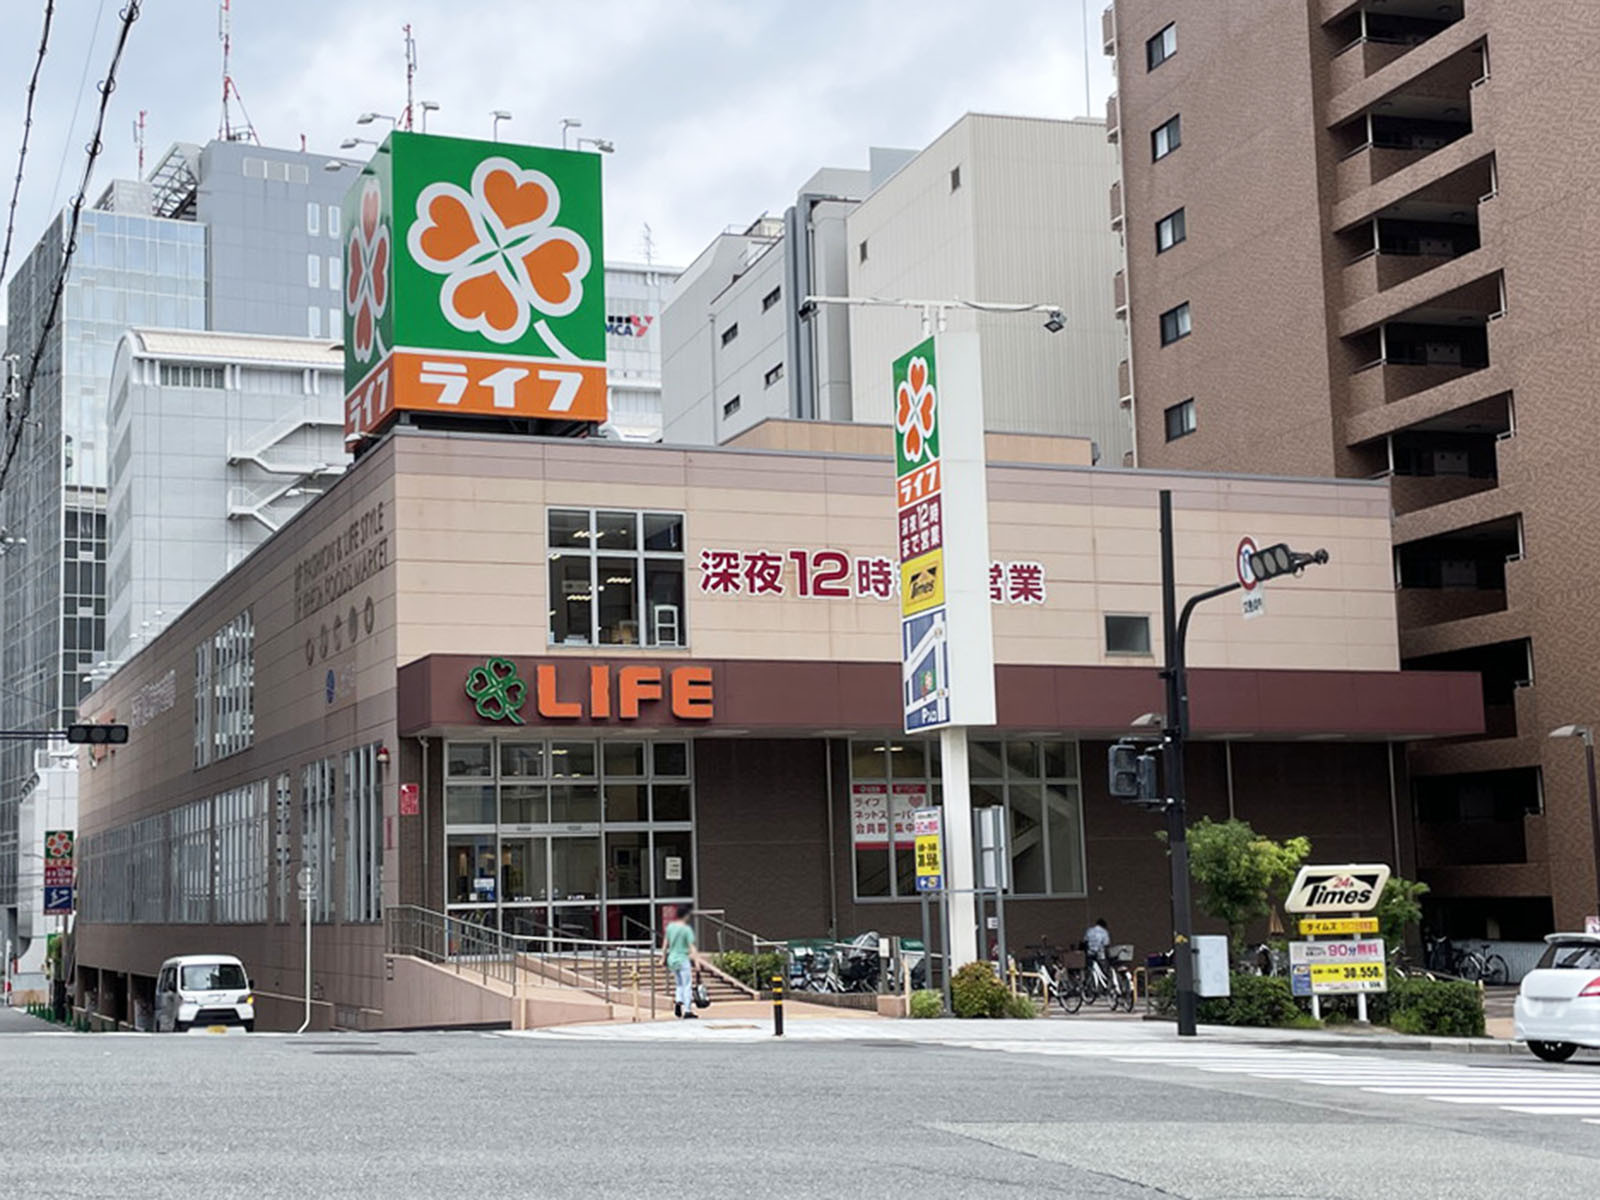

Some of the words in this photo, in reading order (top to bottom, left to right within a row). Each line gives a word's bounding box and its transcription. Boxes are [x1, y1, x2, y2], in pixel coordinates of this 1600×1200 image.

[349, 367, 390, 434] ライフ
[420, 361, 584, 412] ライフ
[900, 465, 937, 503] ライフ
[537, 664, 713, 719] LIFE
[855, 798, 881, 808] ライフ
[1306, 885, 1373, 907] Times
